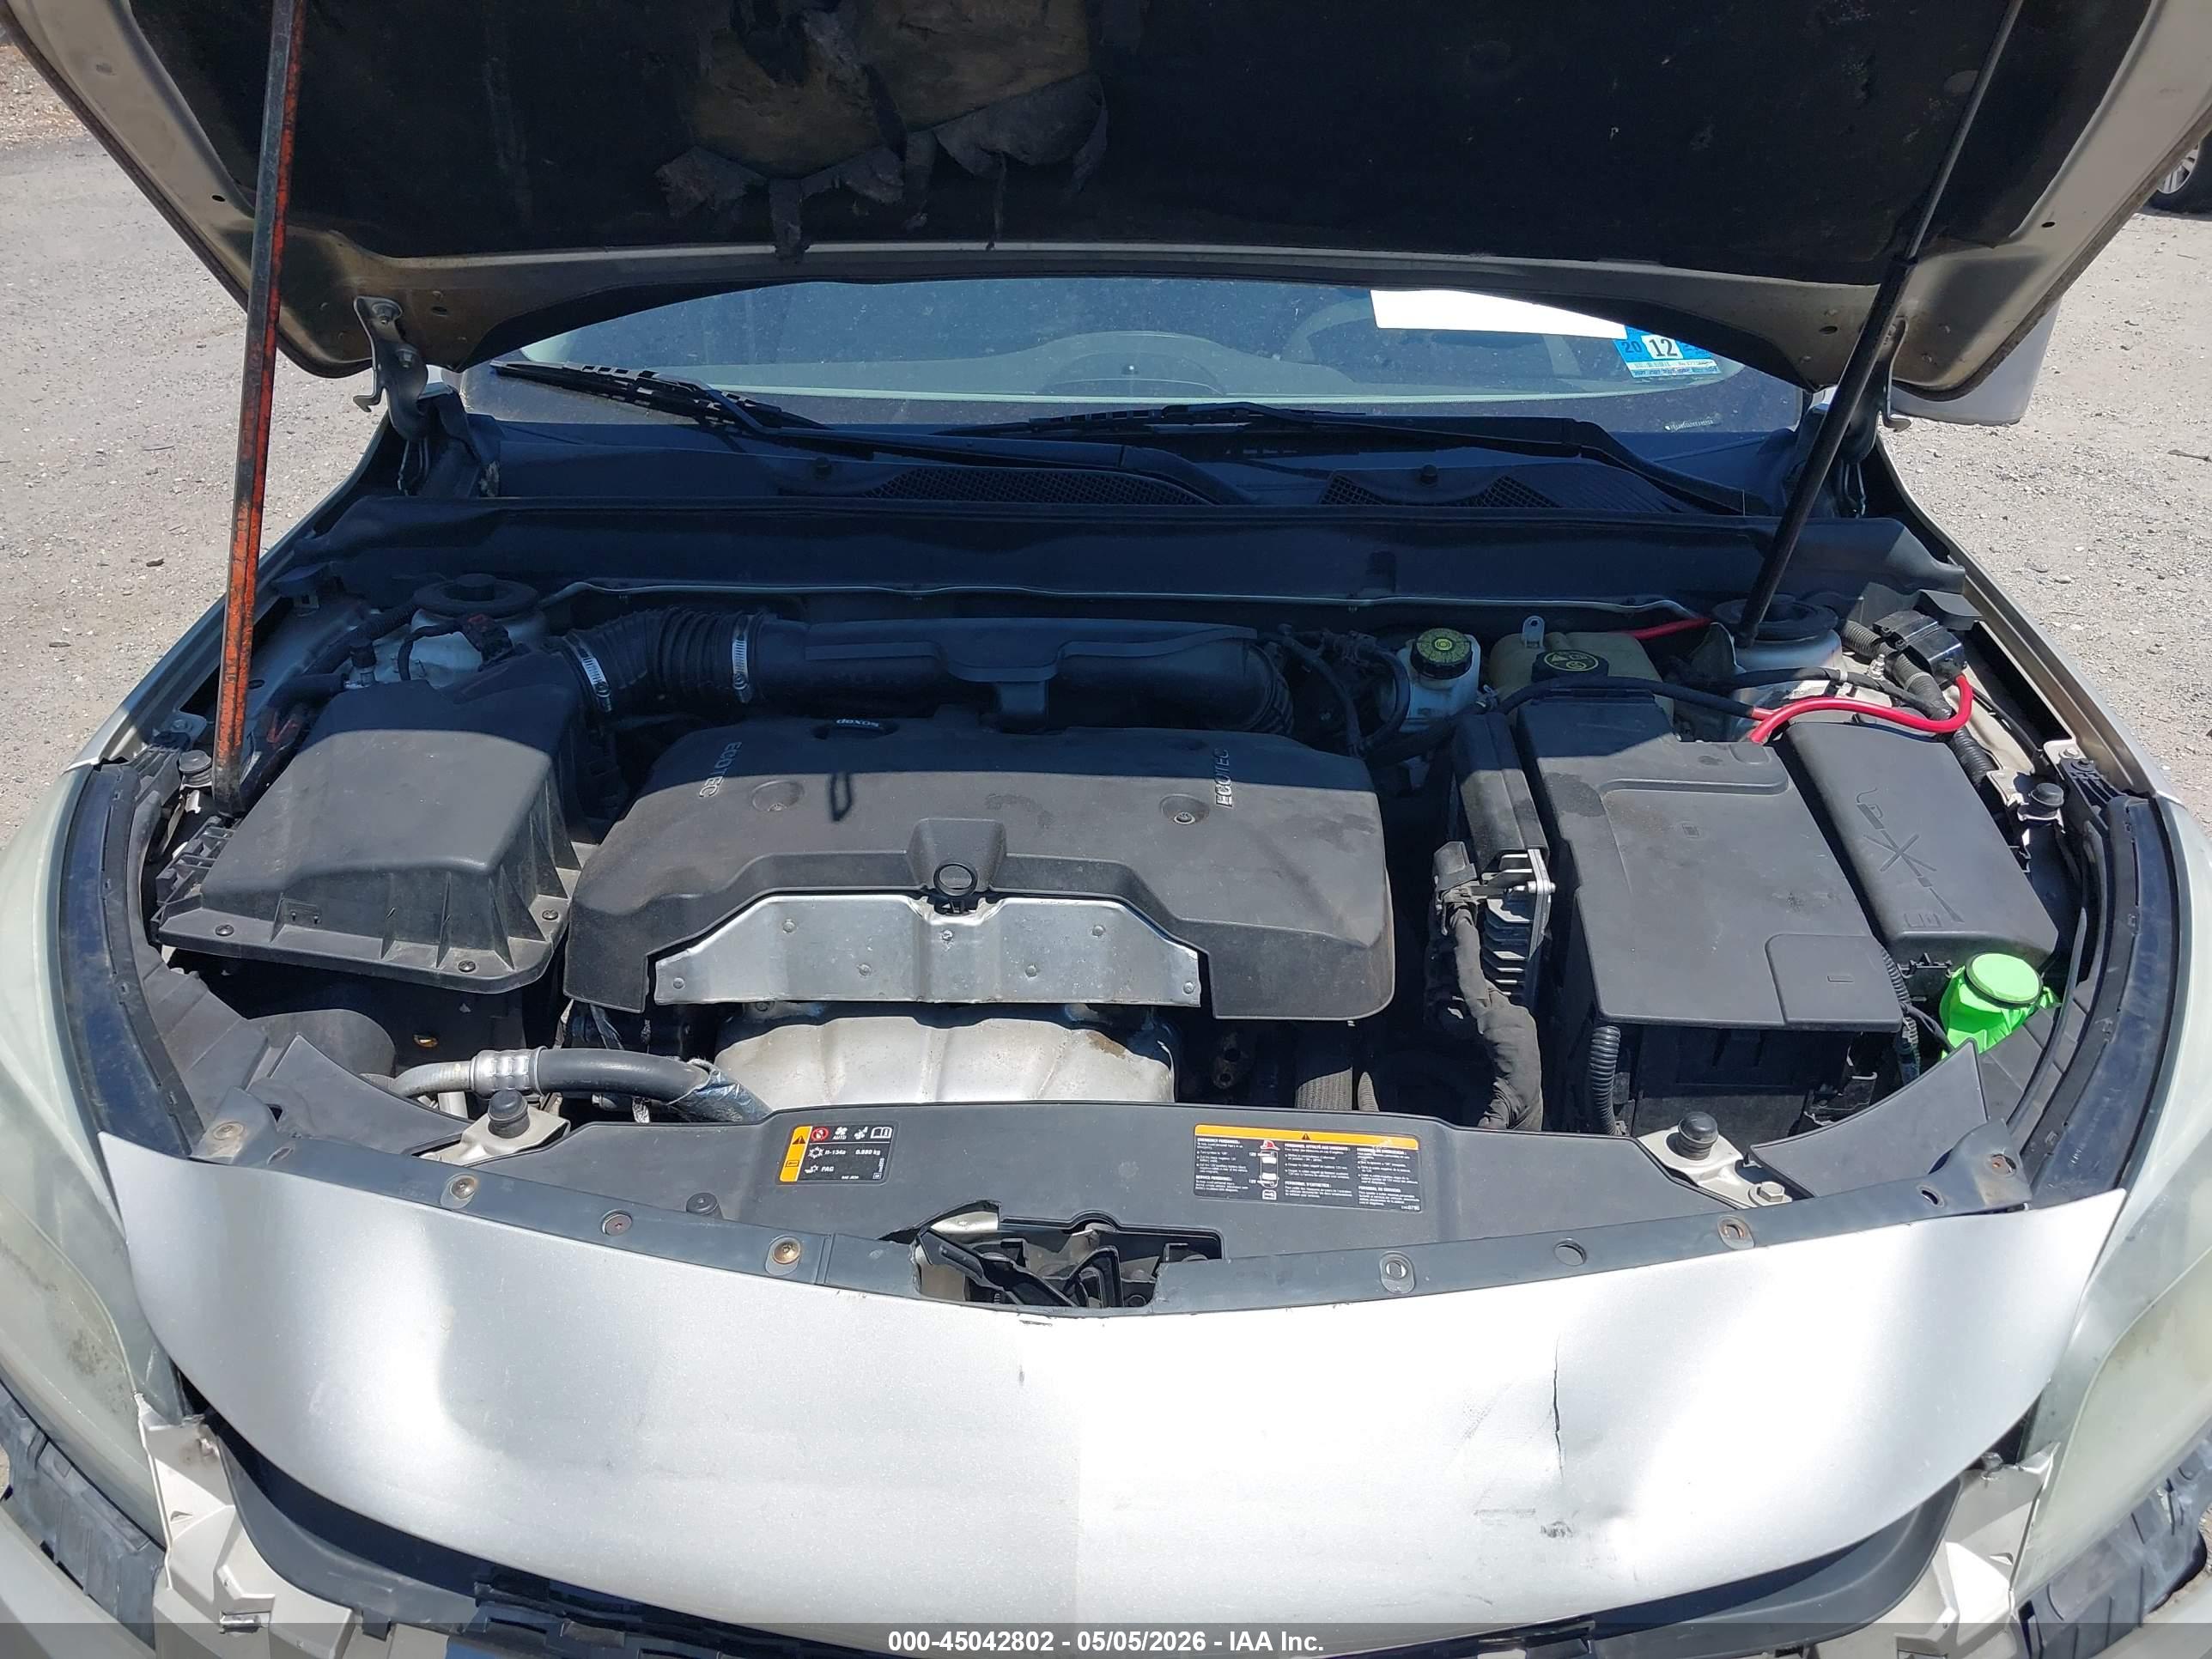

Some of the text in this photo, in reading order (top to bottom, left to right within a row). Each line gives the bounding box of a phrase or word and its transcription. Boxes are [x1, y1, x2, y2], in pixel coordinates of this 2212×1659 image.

[1649, 338, 1678, 357] 12
[836, 718, 880, 728] dexos
[699, 741, 742, 798] ECOTEC
[1213, 748, 1233, 808] ECOTEC
